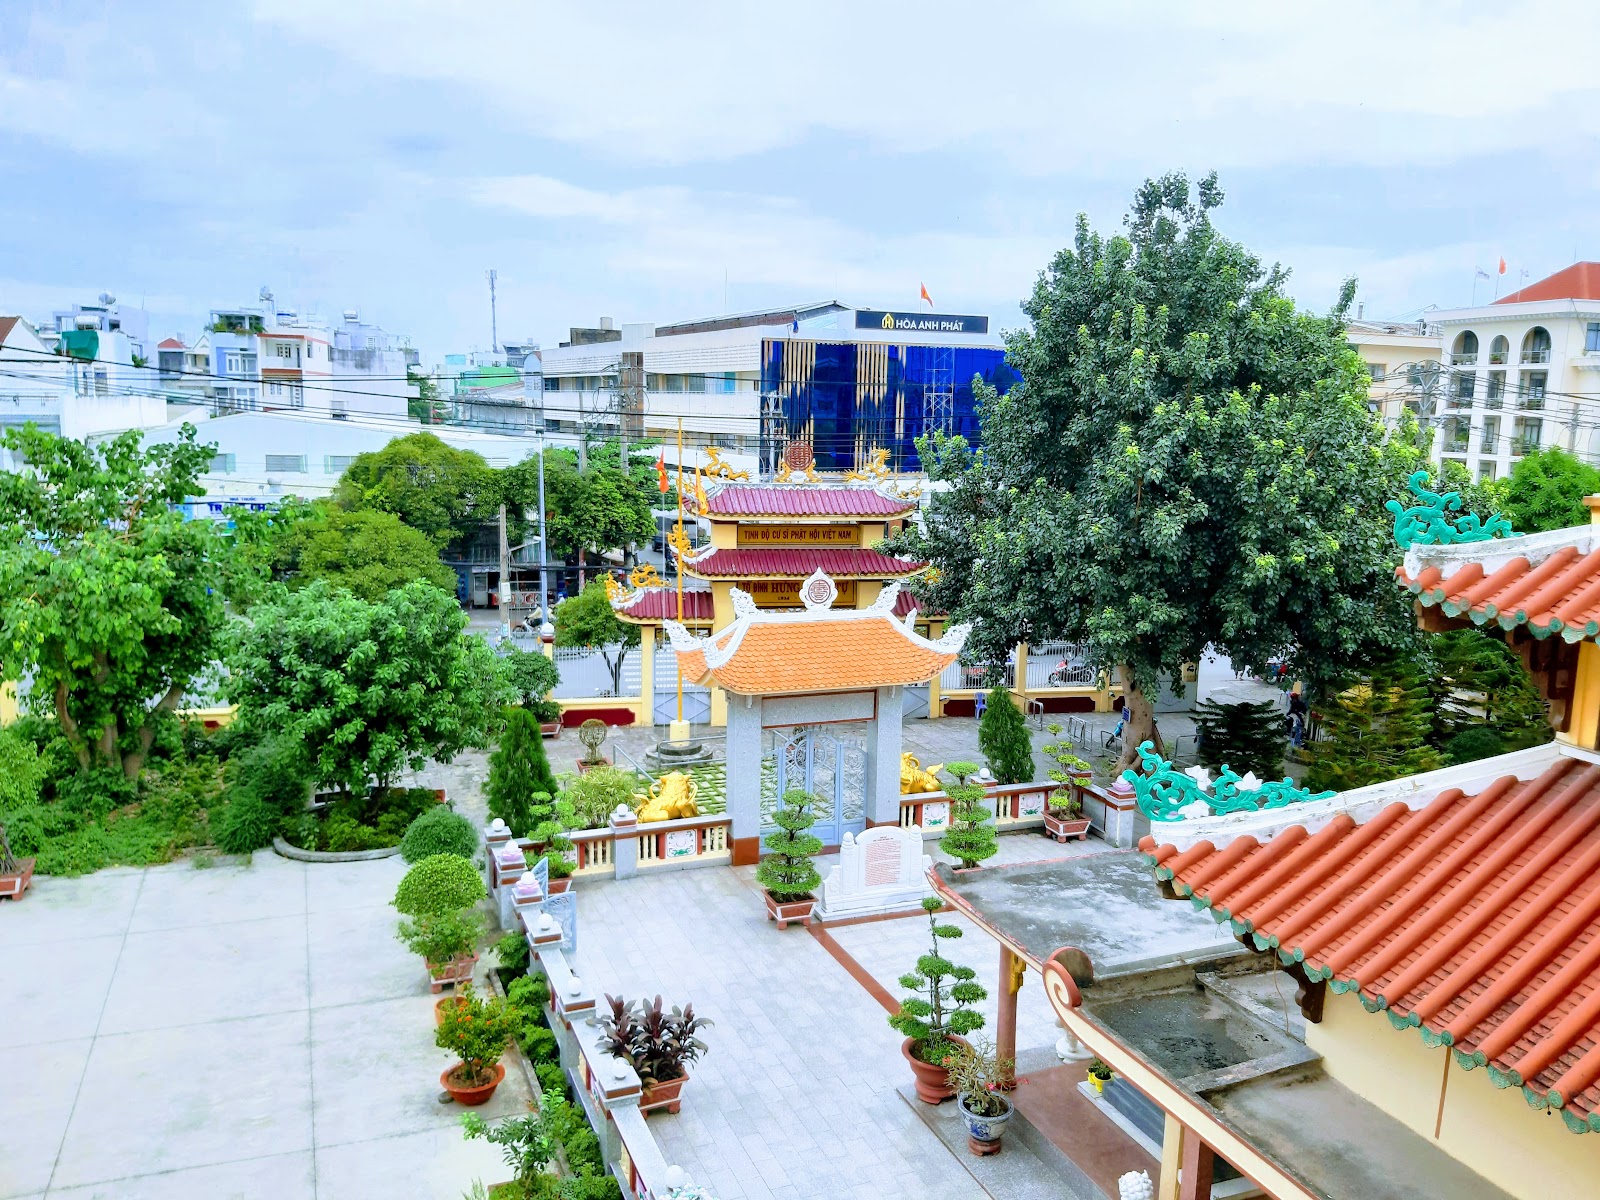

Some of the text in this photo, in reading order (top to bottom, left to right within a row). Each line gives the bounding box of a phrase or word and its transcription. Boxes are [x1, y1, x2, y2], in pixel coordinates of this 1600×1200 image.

[896, 318, 917, 329] HÒA
[918, 321, 939, 330] ANH
[941, 320, 963, 331] PHÁT
[744, 531, 759, 541] TỊNH
[761, 529, 770, 541] ĐỘ
[790, 529, 807, 541] PHẬT
[809, 529, 820, 540] HỘI
[822, 529, 836, 540] VIỆT
[838, 531, 852, 539] NAM
[771, 581, 800, 593] HƯNG
